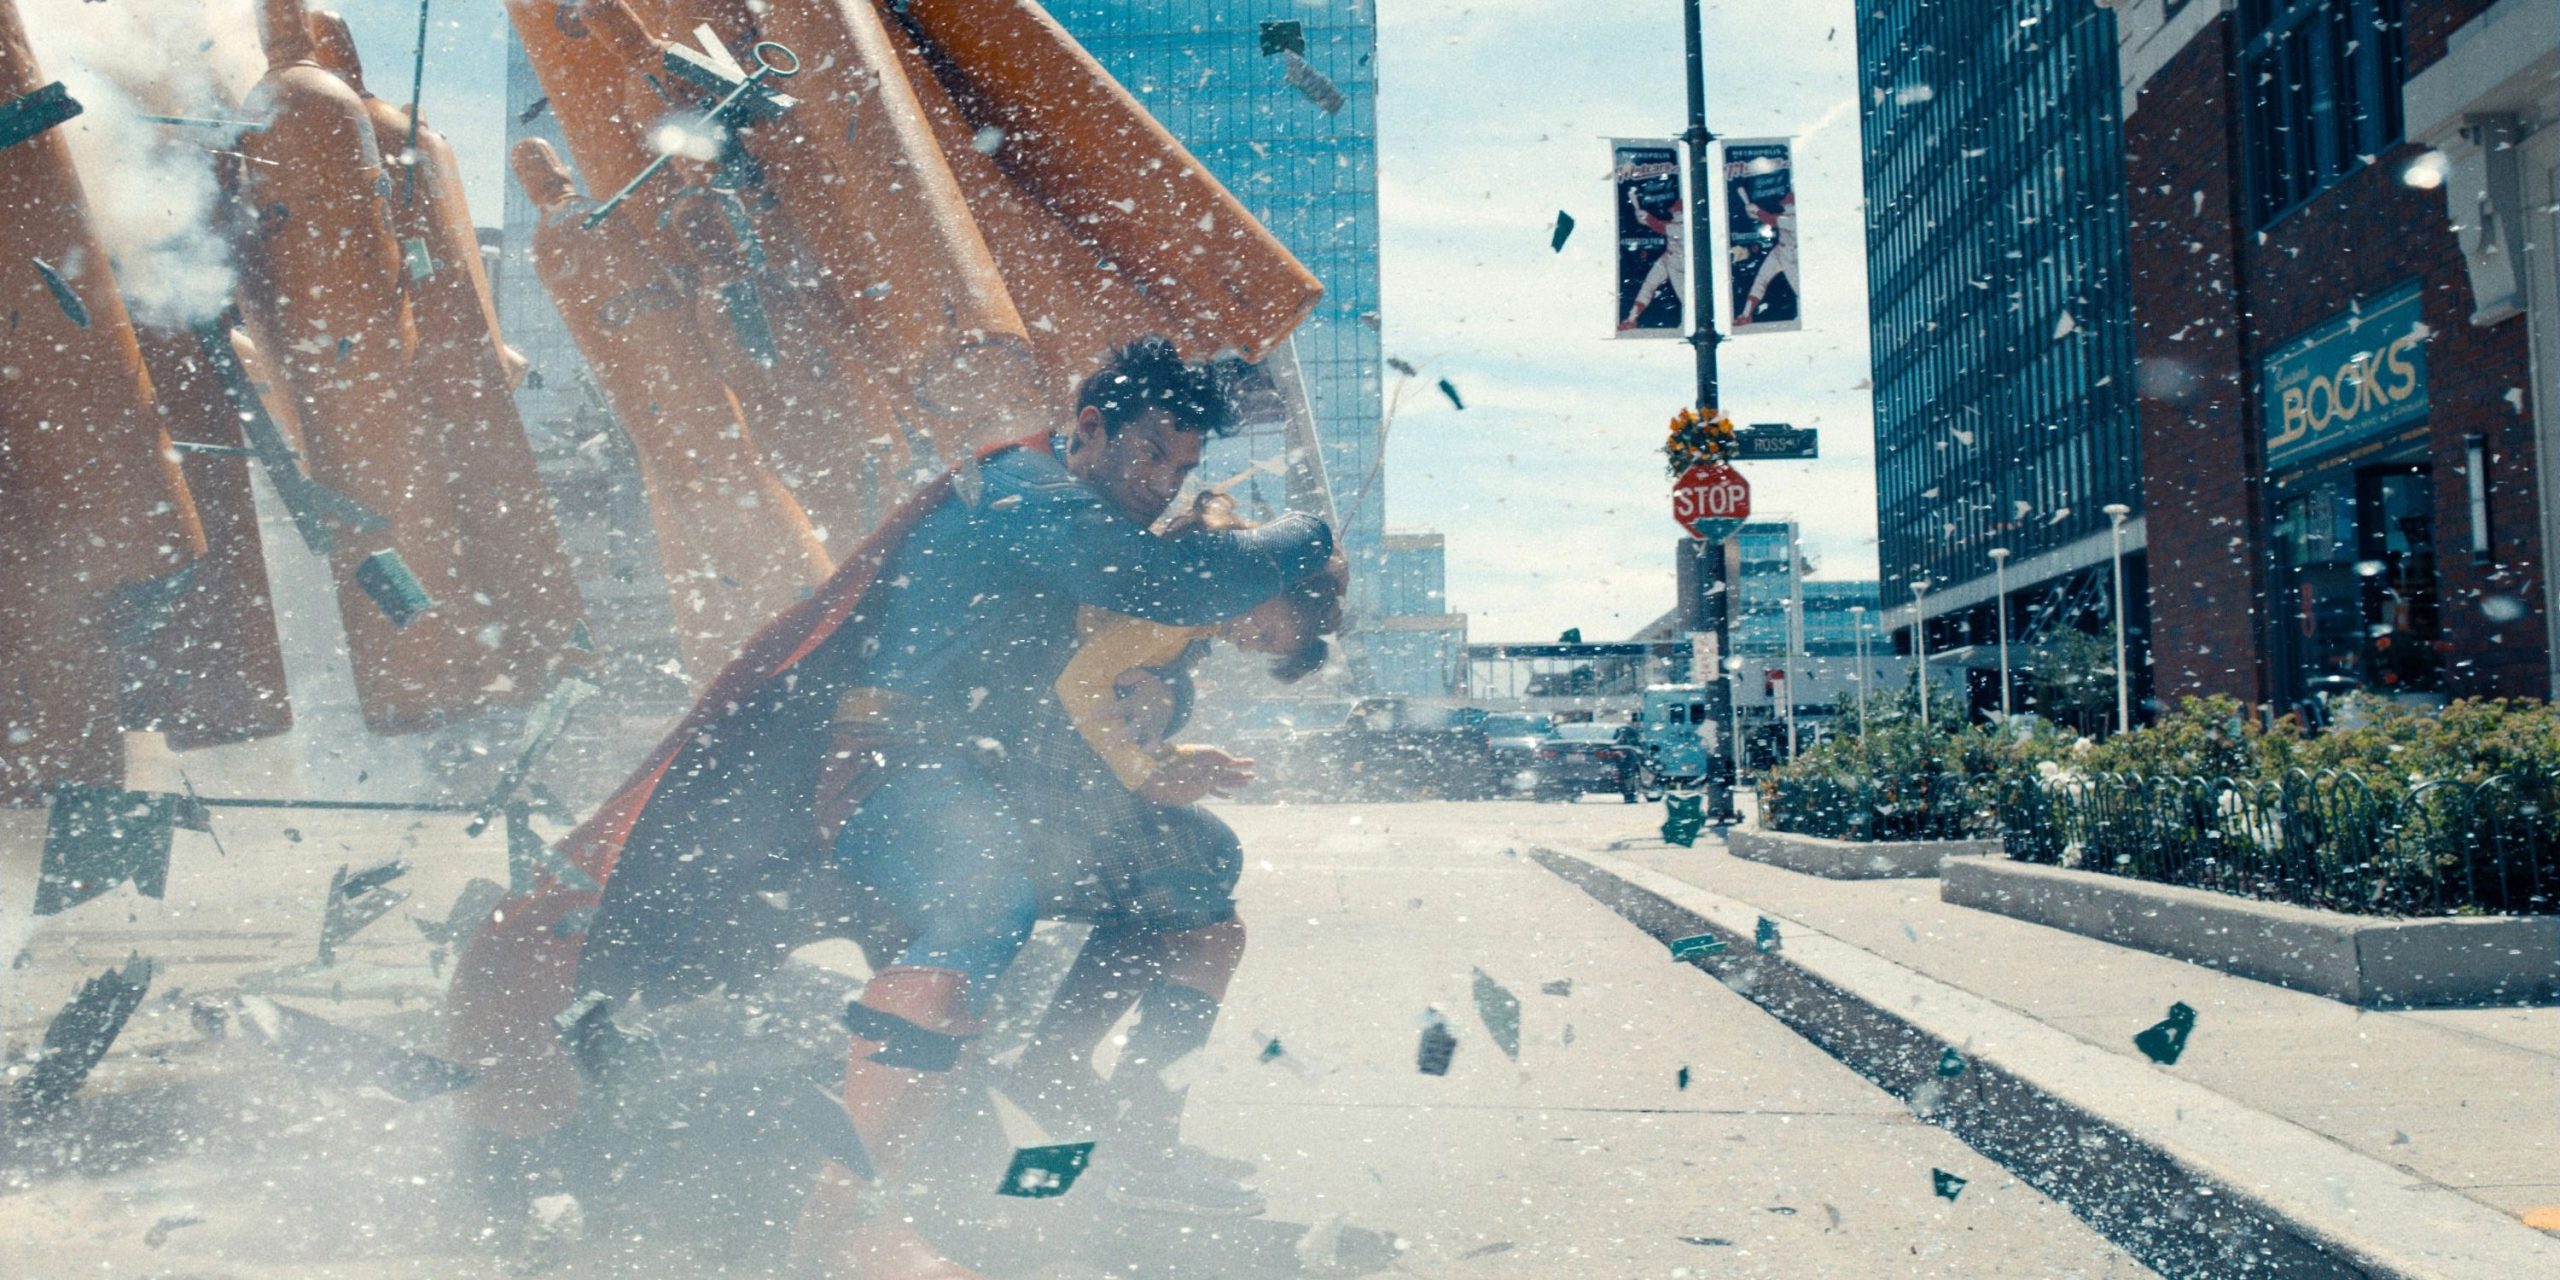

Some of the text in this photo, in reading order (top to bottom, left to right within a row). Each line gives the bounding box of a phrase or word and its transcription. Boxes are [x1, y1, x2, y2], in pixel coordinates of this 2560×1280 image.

[2268, 337, 2427, 449] BOOKS
[1754, 438, 1787, 452] ROSS
[1678, 485, 1746, 516] STOP
